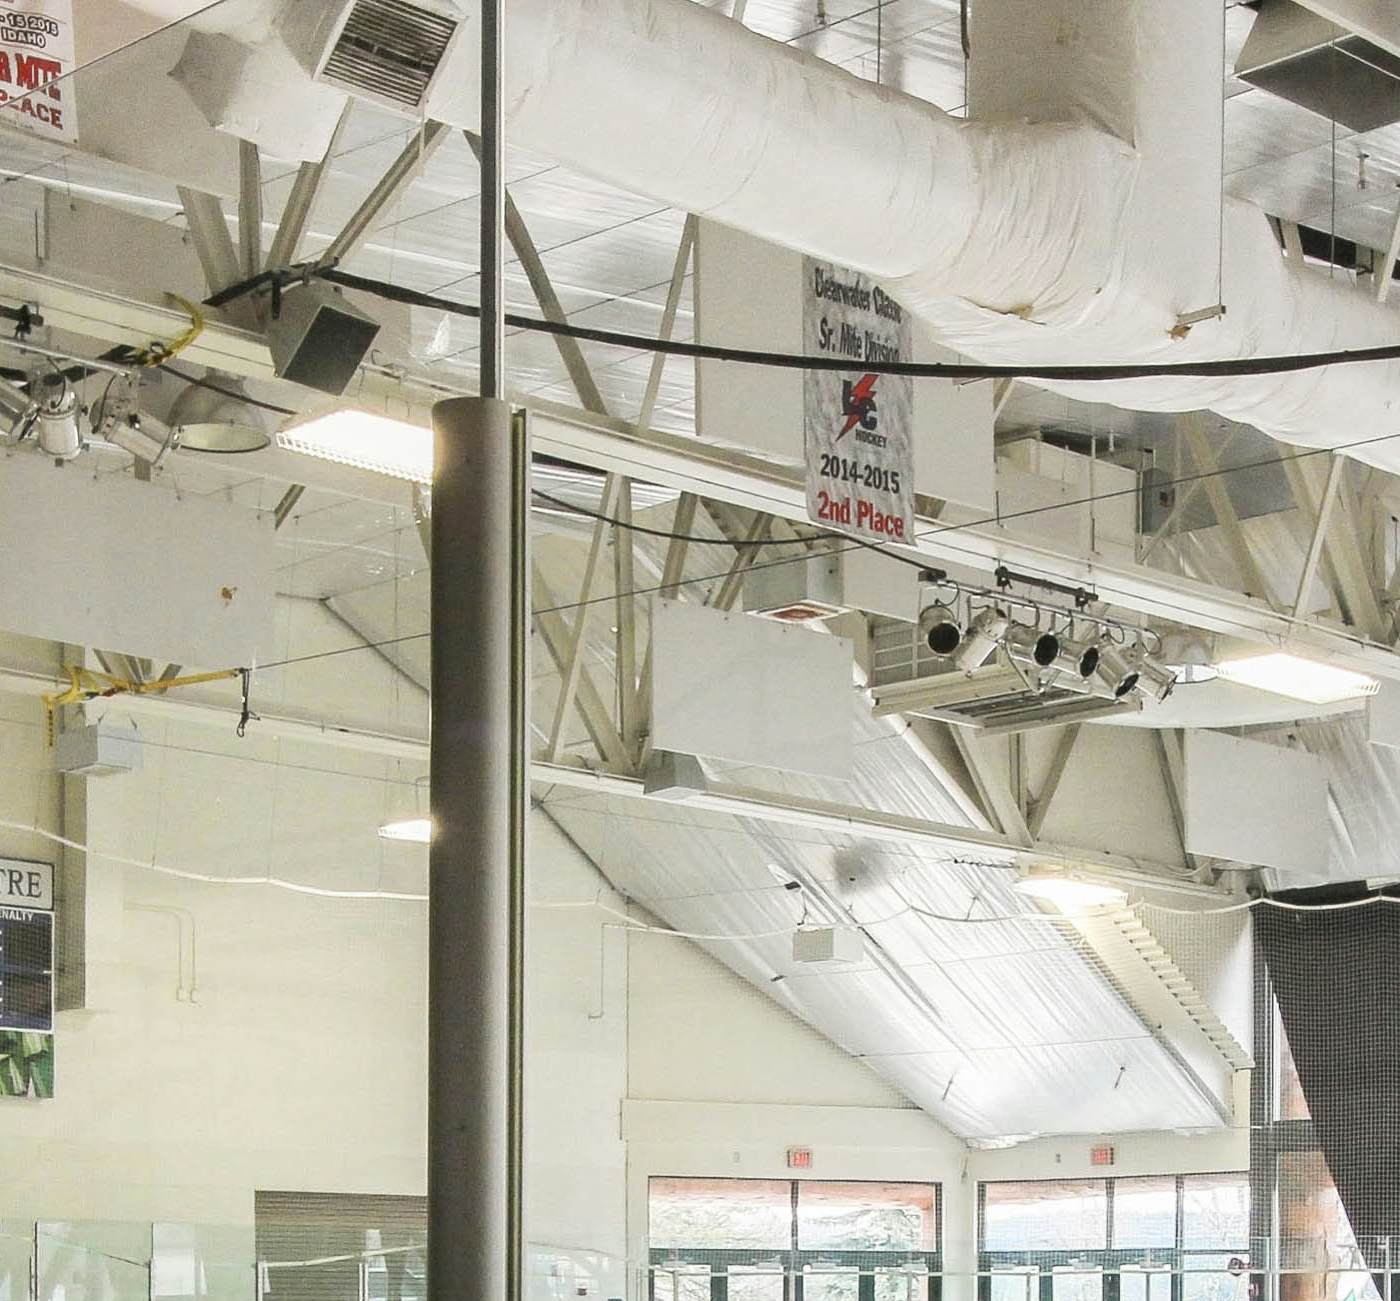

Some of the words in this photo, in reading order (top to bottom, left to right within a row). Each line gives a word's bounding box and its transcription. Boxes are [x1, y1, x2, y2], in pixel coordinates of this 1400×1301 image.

[1, 26, 46, 48] IDAHO
[7, 13, 26, 28] 15
[28, 16, 58, 36] 2015
[15, 53, 61, 101] MITE
[819, 317, 835, 352] Sr.
[855, 428, 887, 448] HOCKEY
[820, 453, 900, 494] 2014-2015
[817, 491, 851, 524] 2nd
[857, 499, 904, 537] Place
